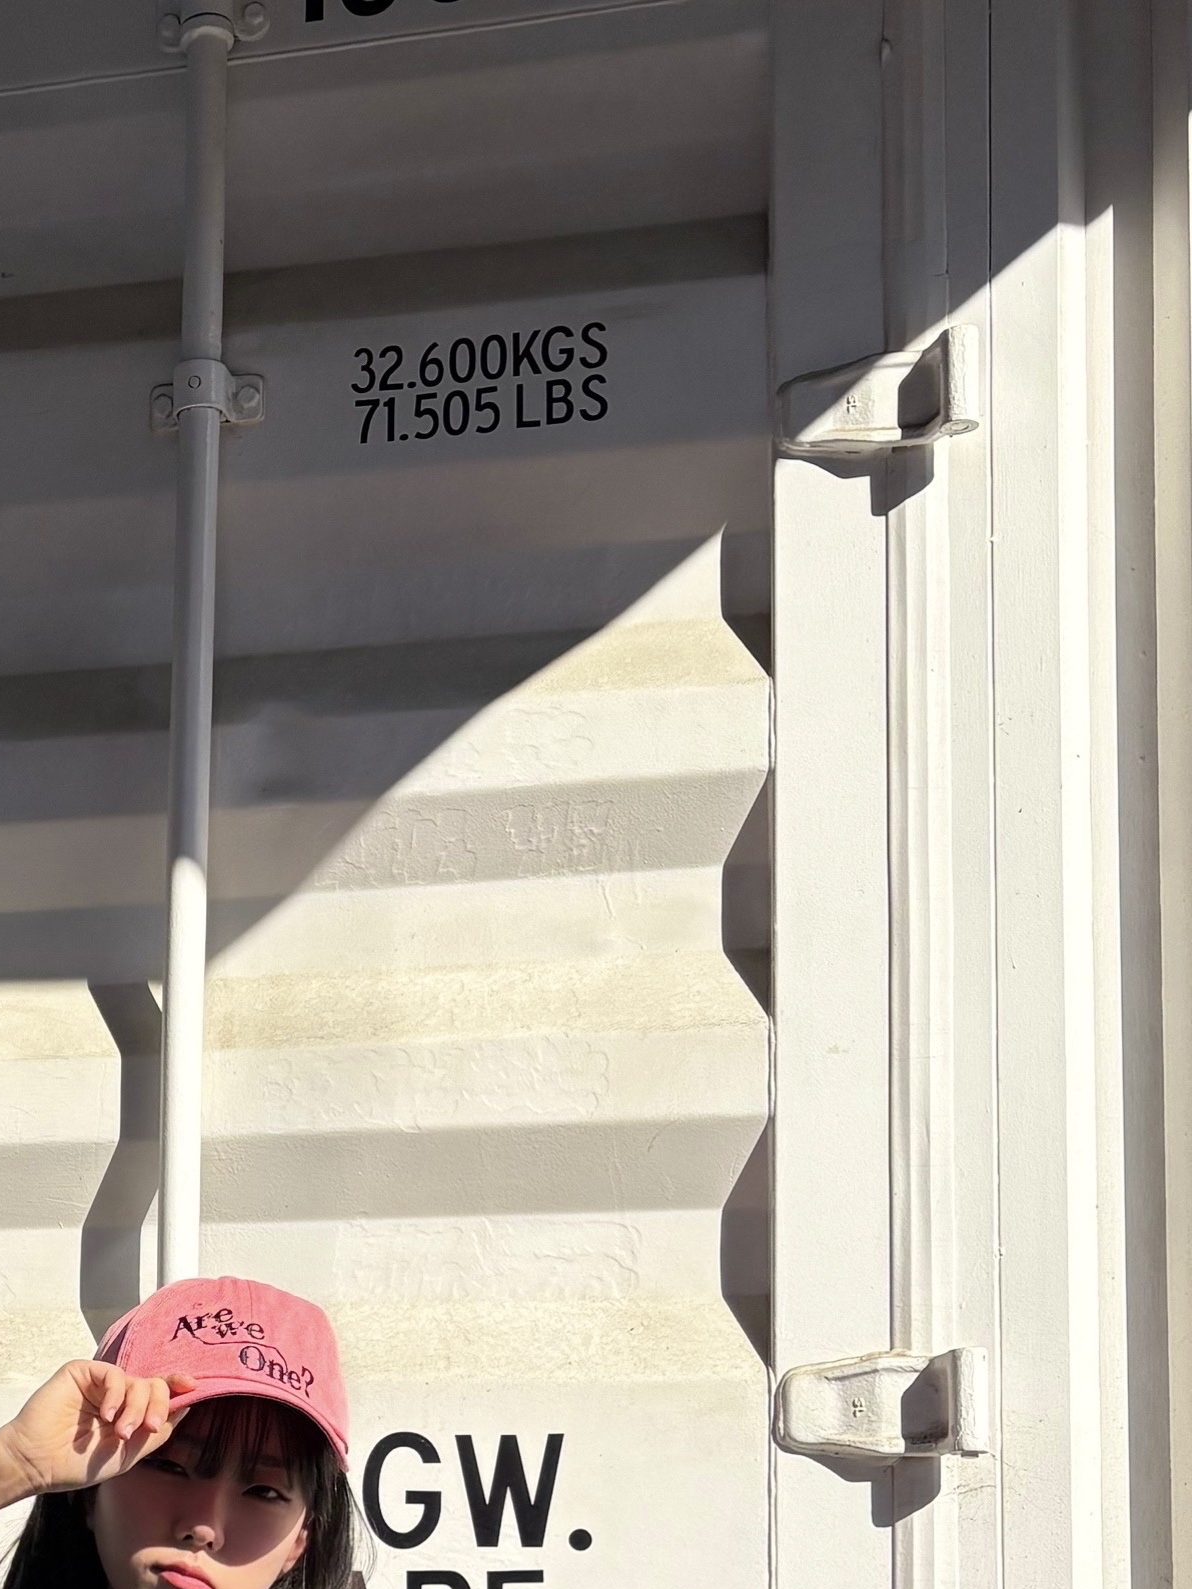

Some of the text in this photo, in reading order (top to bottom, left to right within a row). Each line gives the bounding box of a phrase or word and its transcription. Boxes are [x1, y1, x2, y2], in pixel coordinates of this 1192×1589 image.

[351, 322, 608, 394] 32.600KGS
[354, 374, 608, 444] 71.505 LBS
[169, 1308, 234, 1342] Are
[239, 1346, 314, 1398] One?
